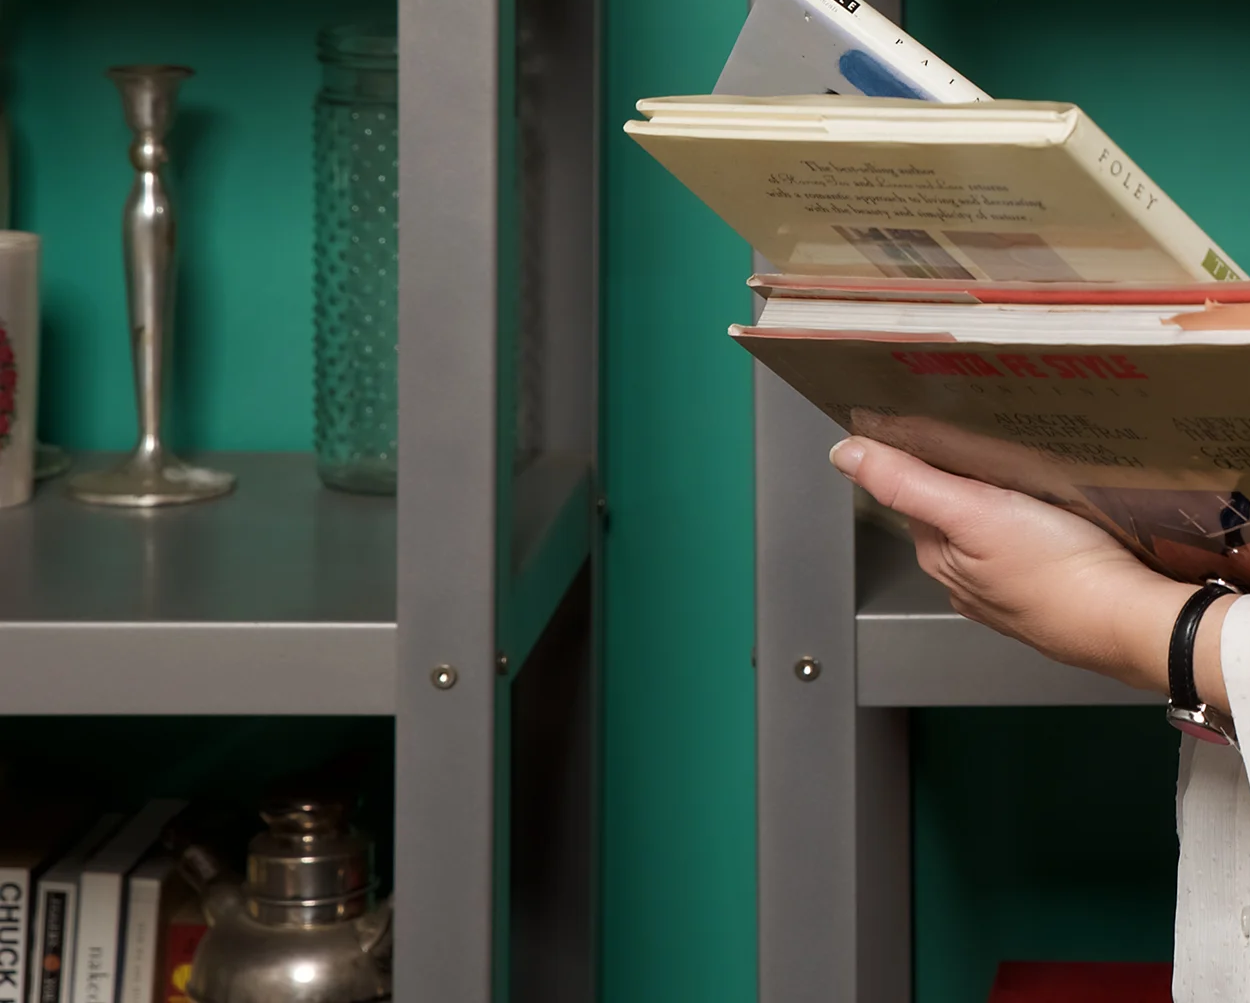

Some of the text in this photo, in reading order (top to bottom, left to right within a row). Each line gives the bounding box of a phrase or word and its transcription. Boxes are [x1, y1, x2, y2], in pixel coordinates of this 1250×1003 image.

[803, 160, 832, 171] The
[852, 177, 874, 186] and
[1098, 148, 1158, 210] FOLEY
[766, 187, 792, 197] with
[855, 192, 907, 204] approach
[920, 192, 959, 207] living
[957, 194, 980, 204] and
[804, 202, 829, 212] with
[831, 203, 850, 213] the
[849, 203, 891, 219] beauty
[892, 206, 914, 216] and
[893, 350, 1149, 379] SANTA FE STYLE
[944, 383, 1151, 397] CONTENTS
[992, 412, 1097, 425] ALONG THE
[1187, 417, 1239, 429] VIEW
[1005, 424, 1067, 436] SANTA
[1063, 426, 1089, 437] FE
[1186, 429, 1229, 442] THE
[1076, 455, 1146, 467] RANCH
[0, 882, 22, 987] CHUCK
